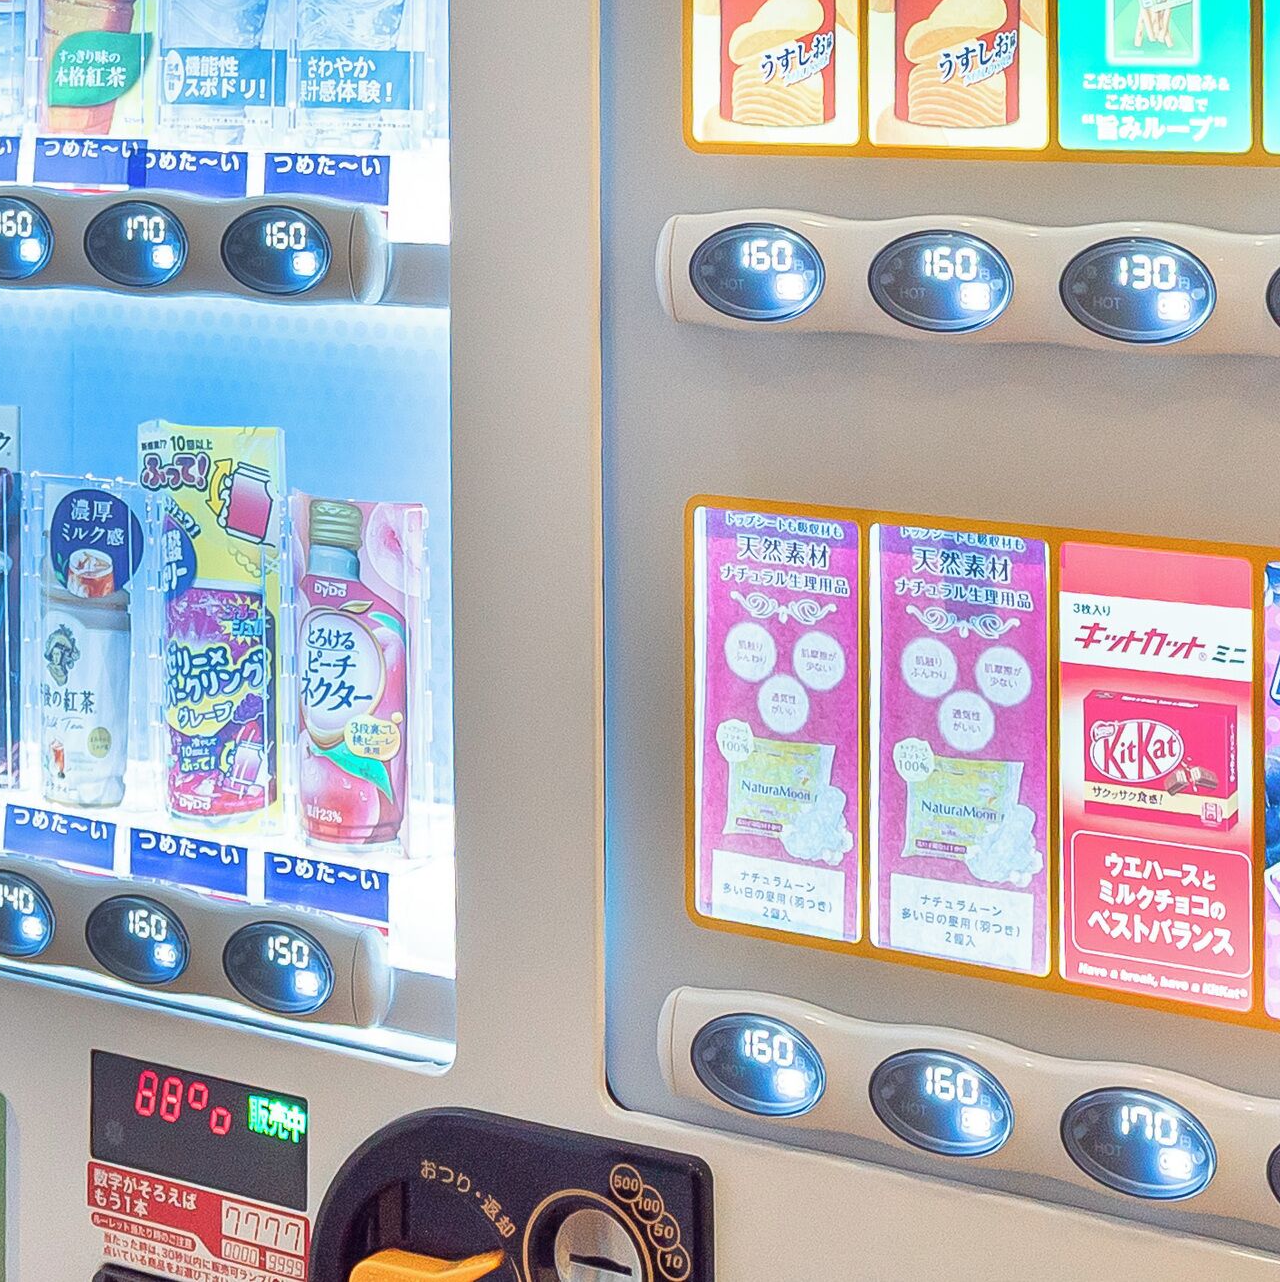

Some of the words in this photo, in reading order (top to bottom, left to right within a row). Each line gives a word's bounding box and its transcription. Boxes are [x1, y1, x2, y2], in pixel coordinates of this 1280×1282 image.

[58, 49, 122, 65] すっきり味の
[185, 55, 239, 78] 機能性
[308, 55, 376, 79] さわやか
[54, 66, 128, 89] 本格紅茶
[185, 77, 267, 101] スポドリ!
[126, 214, 166, 244] 170
[265, 220, 307, 251] 160
[742, 238, 793, 272] 160
[922, 246, 979, 282] 160
[1119, 254, 1177, 290] 130
[140, 450, 211, 493] ふって!
[69, 498, 114, 524] 濃厚
[60, 522, 126, 548] ミルク感
[737, 534, 830, 569] 天然素材
[913, 546, 1012, 583] 天然素材
[313, 580, 348, 598] DyDo
[720, 565, 849, 597] ナチュラル生理用品
[895, 578, 1033, 612] ナチュラル生理用品
[1072, 602, 1112, 618] 3枚入り
[306, 626, 357, 652] とろける
[1074, 621, 1207, 660] キットカット
[1210, 643, 1248, 665] ミニ
[307, 653, 358, 680] ピーチ
[300, 670, 374, 713] ネクター
[1103, 720, 1179, 781] KitKat
[178, 793, 212, 812] DyDo
[740, 779, 812, 802] NaturaMoon
[920, 799, 997, 822] NaturaMoon
[740, 870, 817, 895] ナチュラムーン
[1104, 851, 1217, 892] ウエハースと
[919, 894, 1003, 918] ナチュラムーン
[1098, 878, 1227, 922] ミルクチョコの
[127, 909, 168, 942] 160
[944, 933, 978, 949] 2個入
[1087, 909, 1236, 958] ベストバランス
[267, 934, 310, 970] 150
[743, 1028, 794, 1067] 160
[924, 1065, 980, 1105] 160
[247, 1094, 306, 1144] 販売中
[1120, 1104, 1179, 1146] 170
[93, 1167, 198, 1211] 数字がそろえば
[613, 1174, 639, 1191] 500
[93, 1189, 149, 1218] もう1本
[225, 1206, 302, 1252] 7777
[653, 1223, 675, 1240] 50
[664, 1255, 684, 1271] 10
